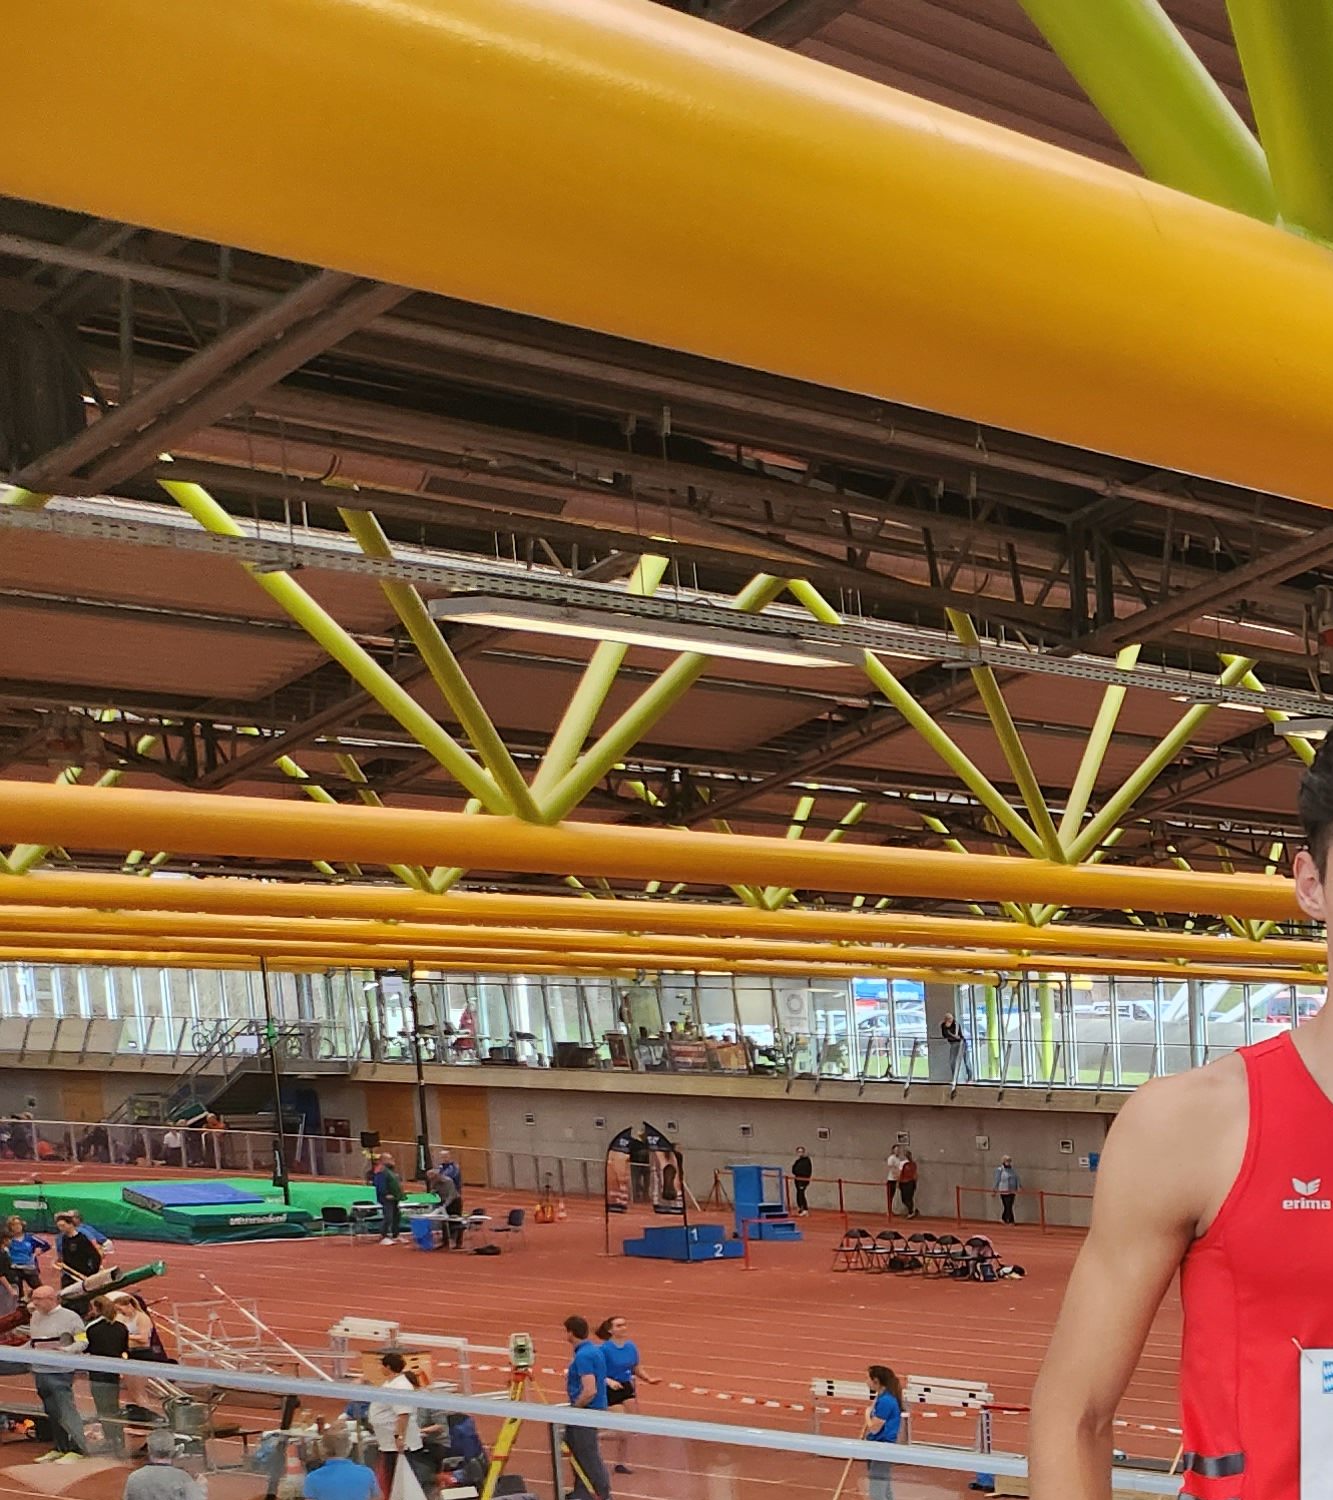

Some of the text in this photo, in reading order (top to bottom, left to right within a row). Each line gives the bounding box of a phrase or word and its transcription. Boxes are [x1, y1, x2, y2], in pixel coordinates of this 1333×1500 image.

[1282, 1197, 1332, 1211] erima
[690, 1227, 699, 1242] 1
[713, 1244, 724, 1258] 2
